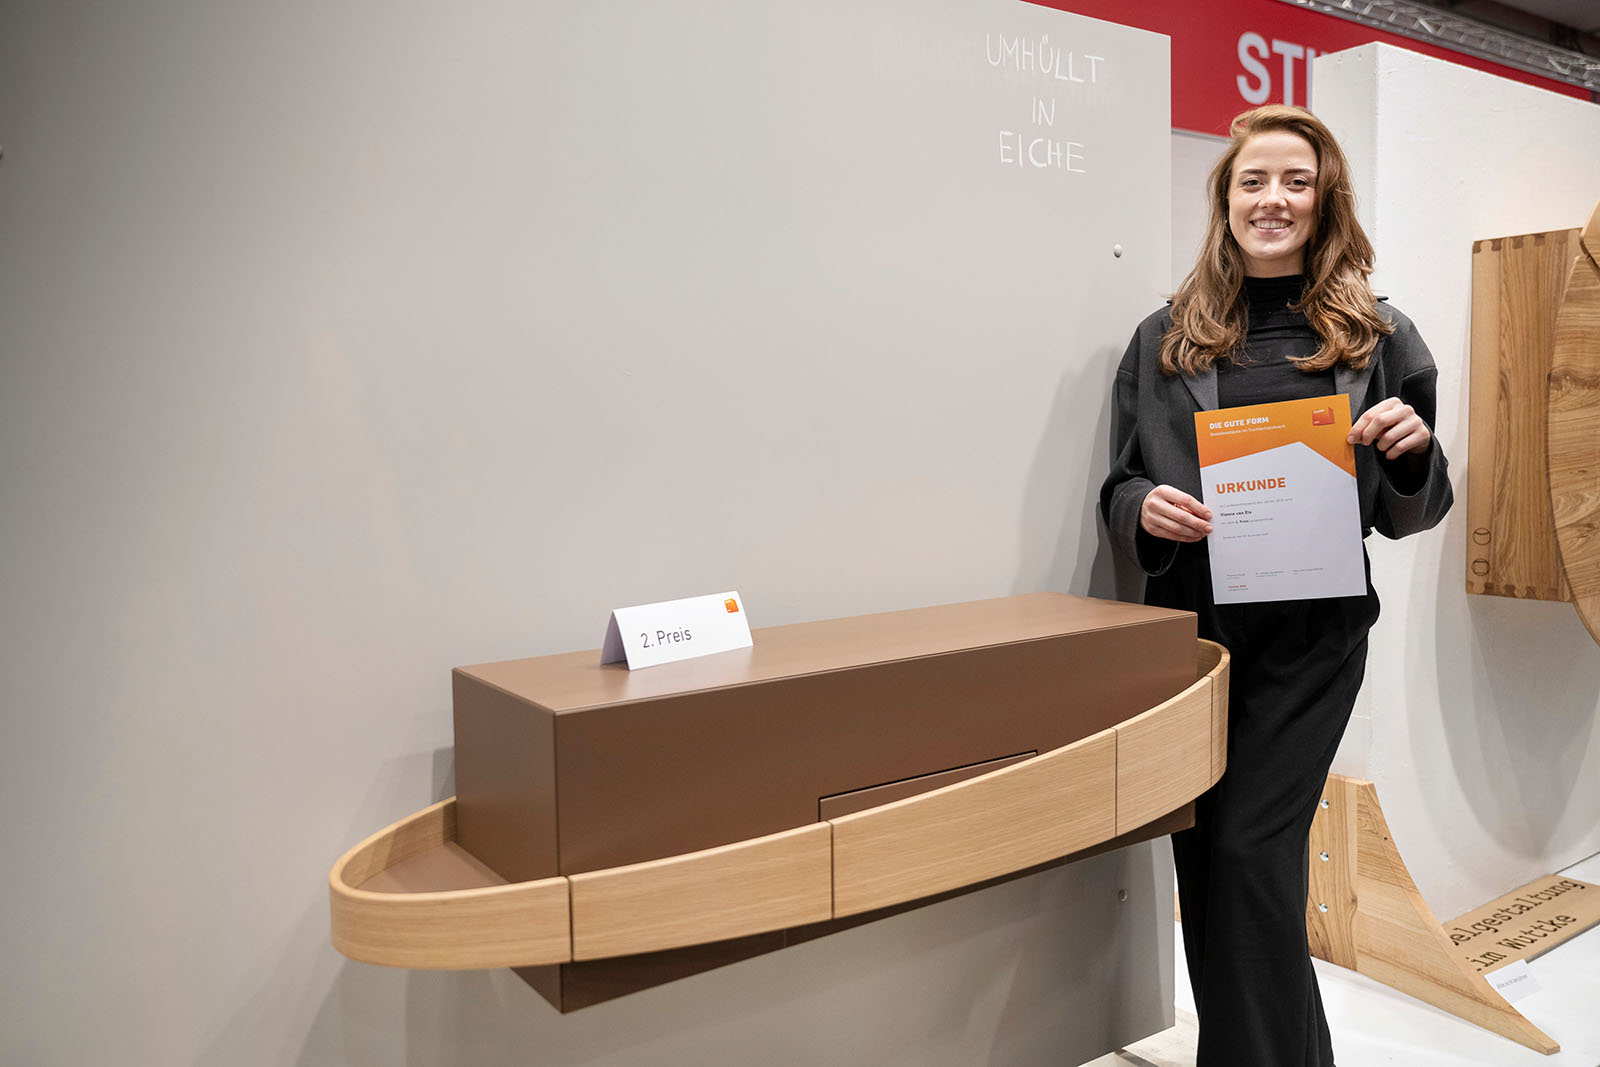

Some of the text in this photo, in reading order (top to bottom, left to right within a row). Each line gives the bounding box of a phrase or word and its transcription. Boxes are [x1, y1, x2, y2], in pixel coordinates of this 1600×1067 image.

[986, 32, 1105, 83] UMHÜLLT
[1236, 31, 1330, 112] STI
[1032, 96, 1055, 127] IN
[1000, 130, 1087, 174] EICHE
[1209, 416, 1270, 430] DIE GUTE FORM
[1216, 477, 1286, 495] URKUNDE
[640, 626, 692, 649] 2. Preis
[1465, 914, 1577, 972] im Wuttke
